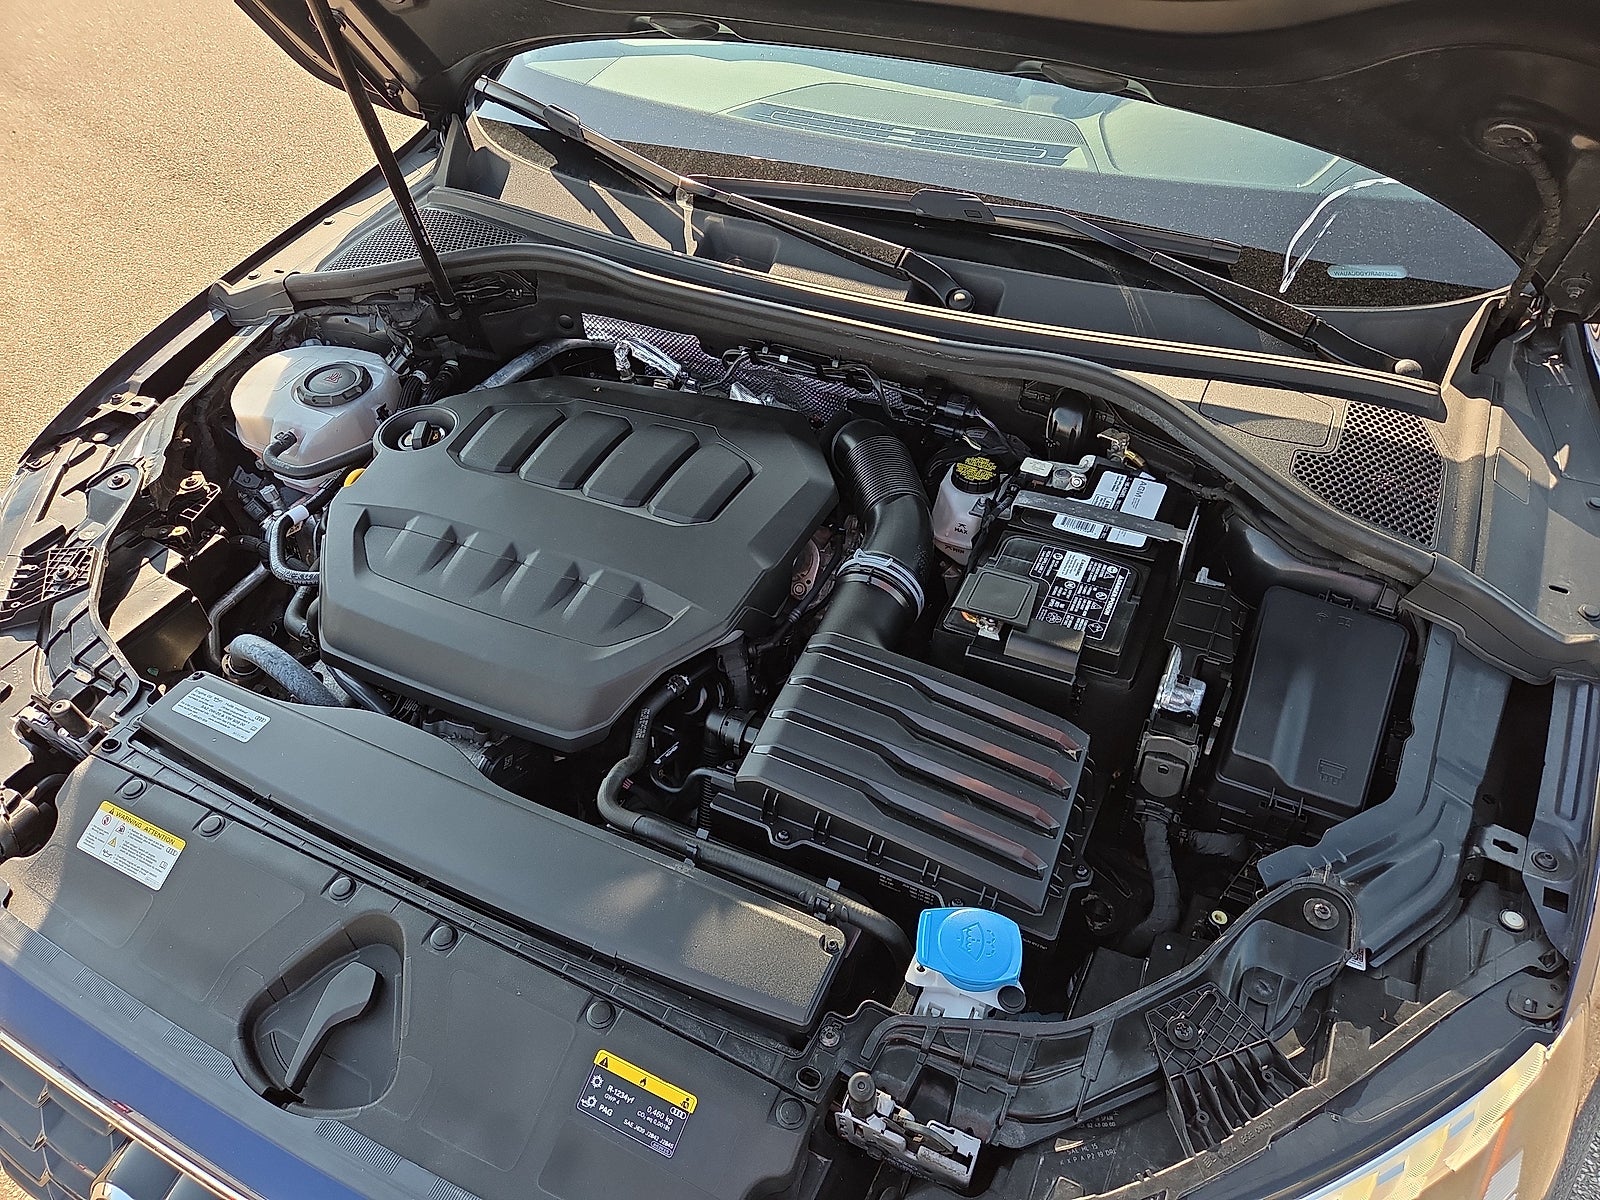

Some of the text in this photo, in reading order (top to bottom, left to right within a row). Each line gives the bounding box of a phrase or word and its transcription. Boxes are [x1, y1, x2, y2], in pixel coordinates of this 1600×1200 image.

[1134, 481, 1147, 498] AGM
[954, 527, 968, 535] MAX
[114, 811, 142, 829] WARNING
[144, 826, 176, 845] ATTENTION
[606, 1084, 636, 1104] R-1234yf
[598, 1104, 614, 1117] PAG
[623, 1118, 635, 1129] SAE
[664, 1115, 674, 1126] kg
